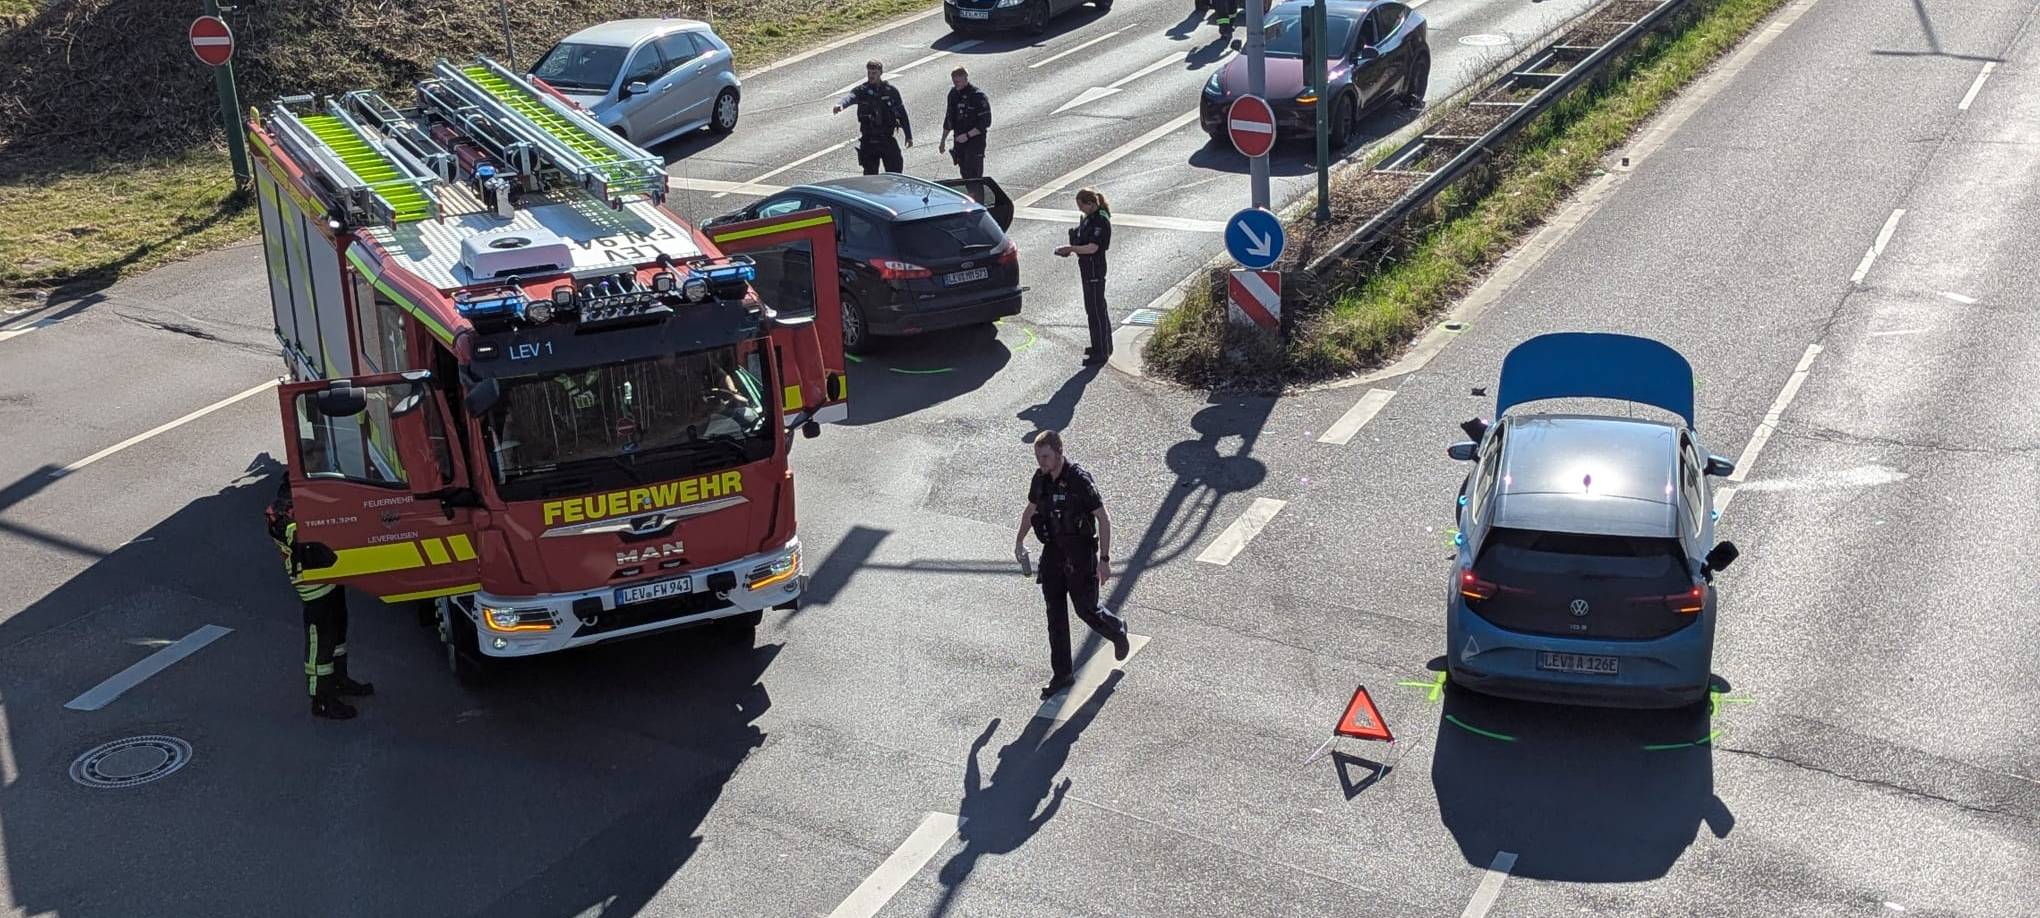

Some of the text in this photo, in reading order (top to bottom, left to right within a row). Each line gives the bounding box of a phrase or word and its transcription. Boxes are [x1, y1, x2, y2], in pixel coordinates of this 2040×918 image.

[603, 244, 662, 262] LEV
[509, 341, 553, 360] LEV 1
[363, 496, 414, 508] FEUERWEHR
[543, 470, 744, 526] FEUERWEHR
[367, 531, 418, 544] LEVERKUSEN
[616, 541, 685, 566] MAN
[623, 579, 691, 603] LEV FW 941
[1544, 654, 1617, 672] LEV A 126E
